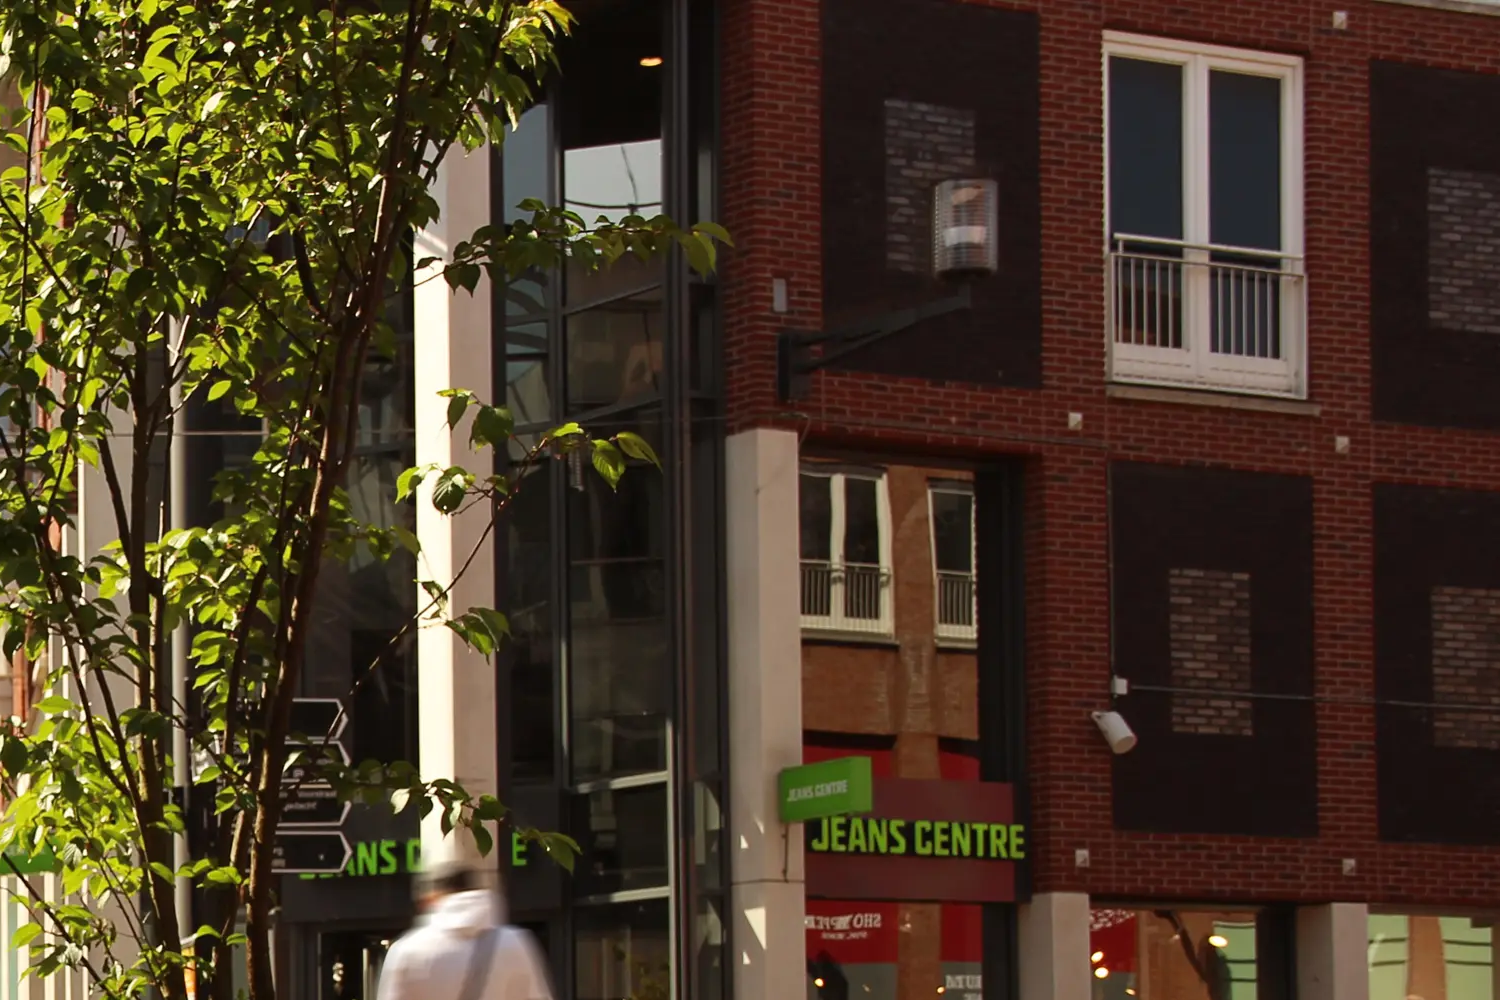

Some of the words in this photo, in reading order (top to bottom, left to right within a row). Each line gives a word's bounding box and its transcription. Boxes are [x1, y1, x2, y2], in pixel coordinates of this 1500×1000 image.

[787, 785, 814, 802] JEANS
[815, 779, 848, 798] CENTRE
[811, 815, 906, 853] JEANS
[914, 821, 1025, 859] CENTRE
